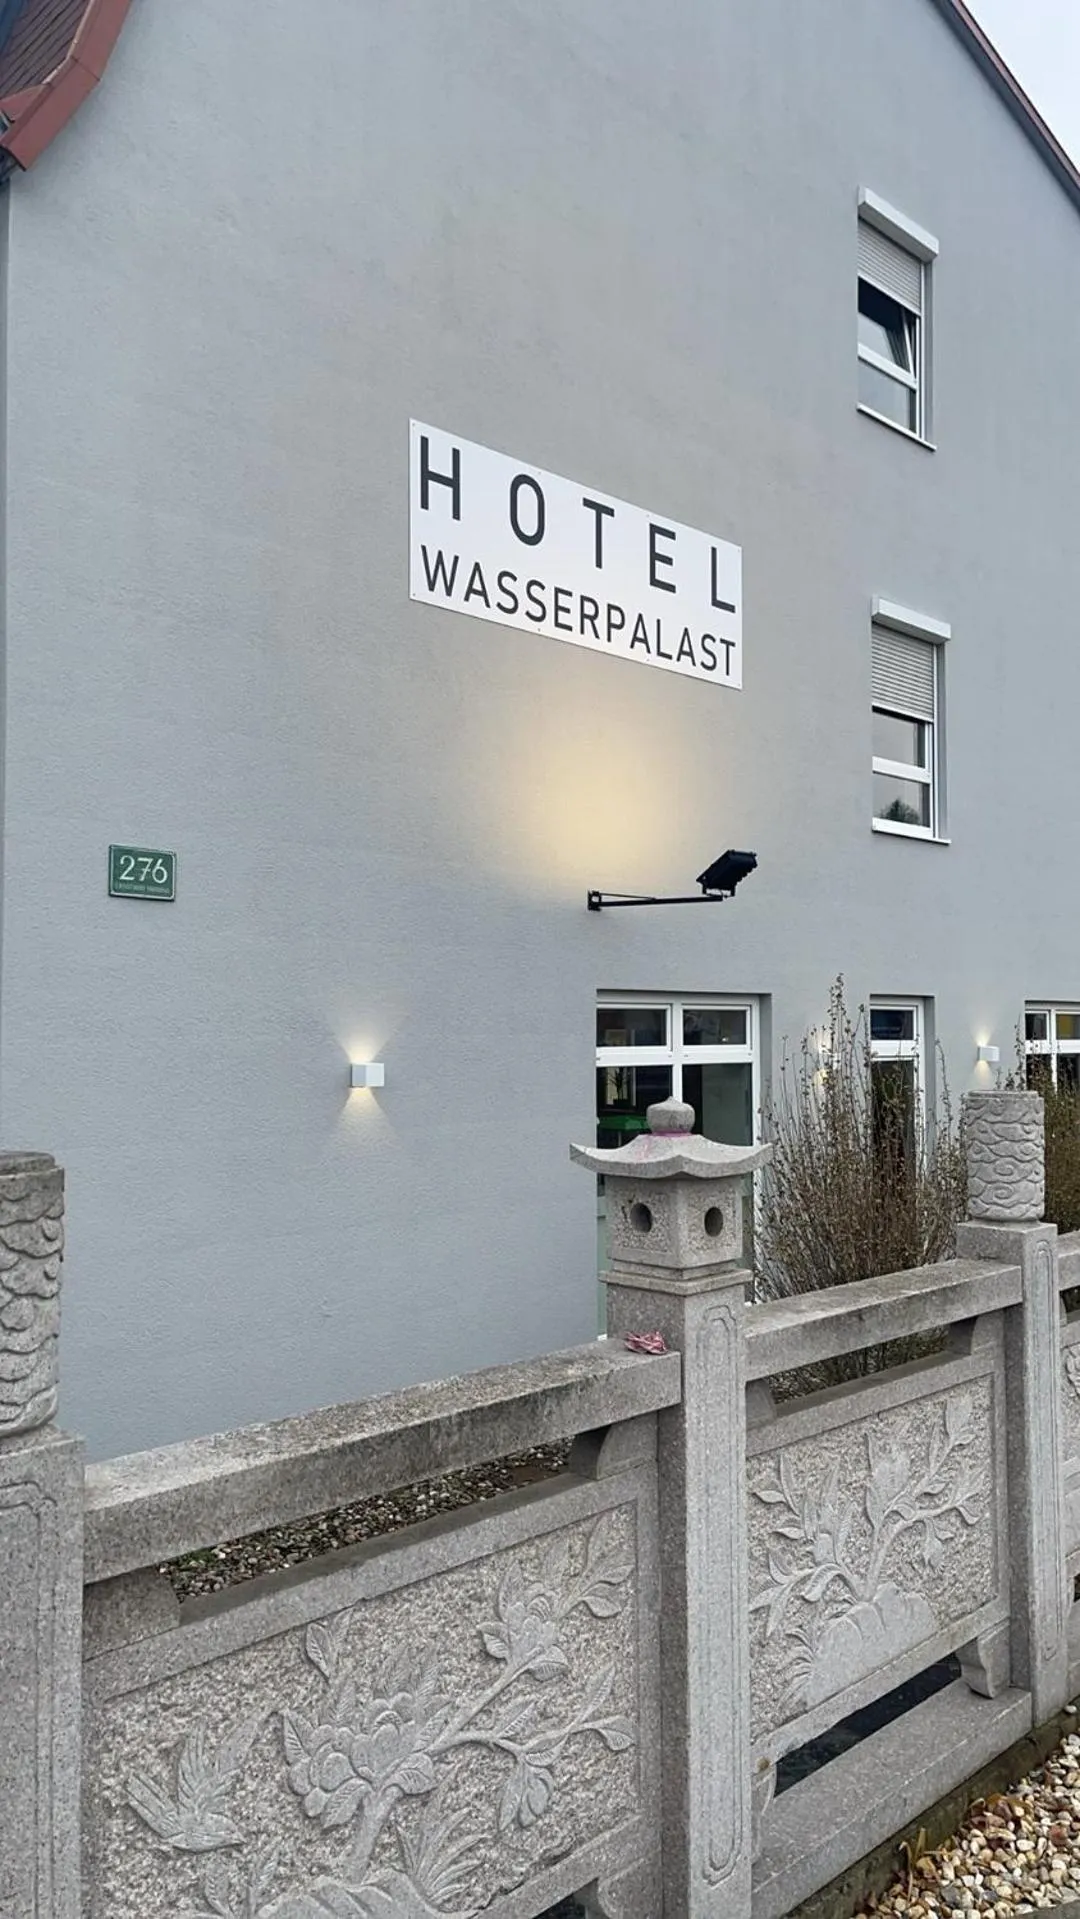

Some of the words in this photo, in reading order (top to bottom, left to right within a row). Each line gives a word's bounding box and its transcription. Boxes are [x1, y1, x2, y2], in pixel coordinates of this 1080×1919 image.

[420, 436, 736, 613] HOTEL
[421, 544, 736, 676] WASSERPALAST
[119, 855, 168, 883] 276
